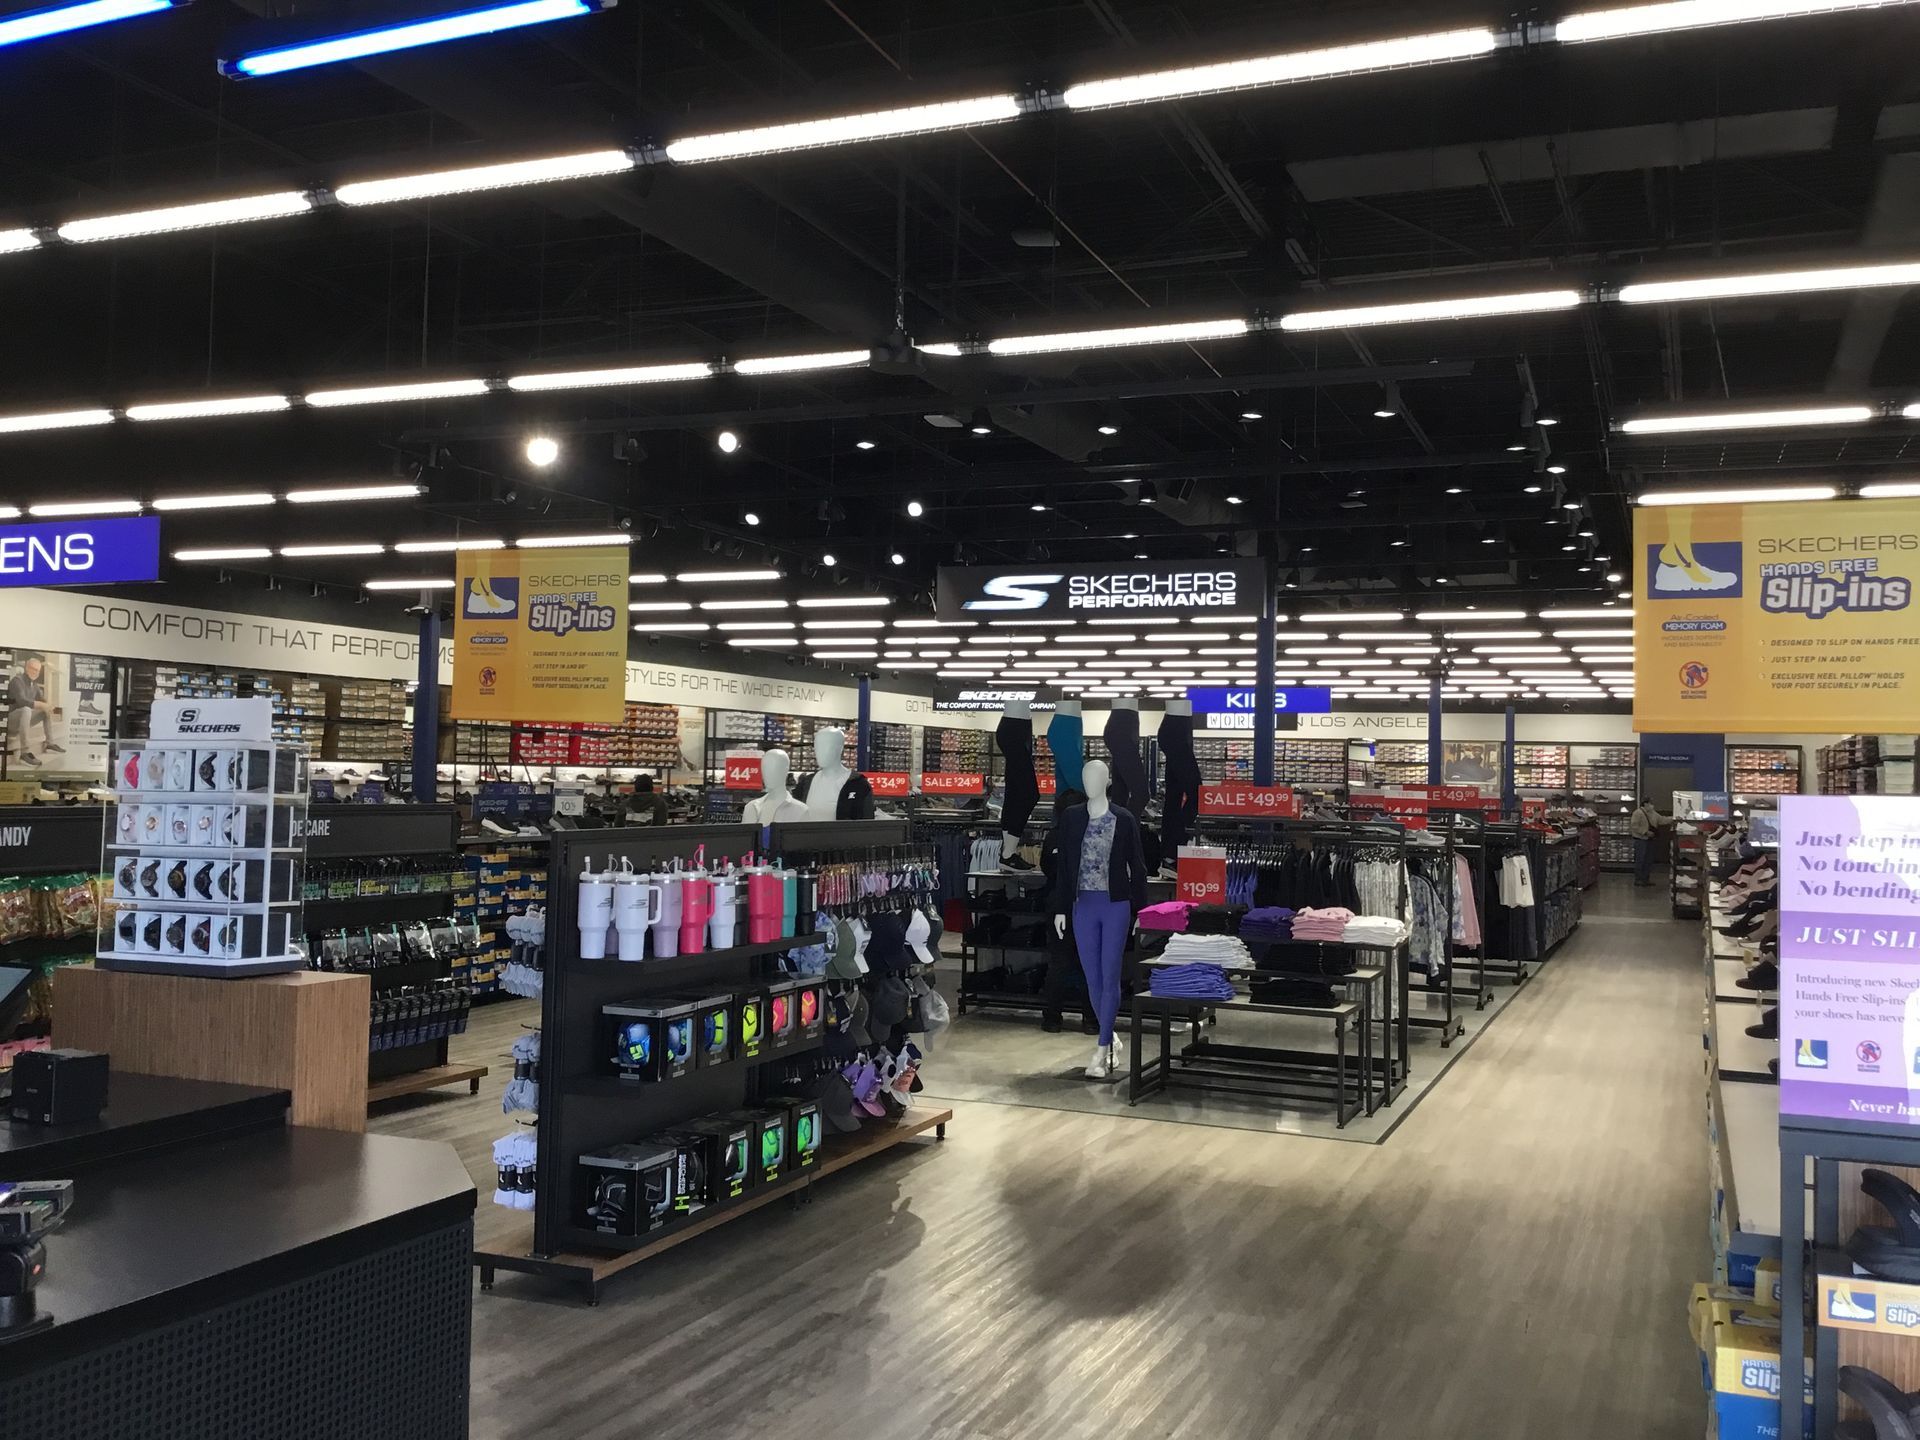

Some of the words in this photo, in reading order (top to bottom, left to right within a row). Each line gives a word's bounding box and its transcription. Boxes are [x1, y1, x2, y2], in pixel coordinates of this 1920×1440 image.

[1758, 535, 1920, 553] SKECHERS
[0, 533, 94, 573] ENS
[1760, 562, 1824, 577] HANDS
[1829, 558, 1878, 573] FREE
[529, 575, 621, 587] SKECHERS
[1069, 572, 1236, 594] SKECHERS
[529, 594, 566, 604] HANDS
[570, 592, 597, 603] FREE
[1069, 592, 1236, 608] PERFORMANCE
[1764, 576, 1908, 616] Slip-ins
[83, 604, 242, 642] COMFORT
[253, 625, 322, 650] THAT
[530, 604, 614, 634] Slip-ins
[1665, 622, 1699, 631] MEMORY
[1701, 622, 1724, 630] FOAM
[75, 681, 93, 689] WIDE
[681, 675, 709, 690] FOR
[713, 678, 737, 694] THE
[741, 681, 784, 698] WHOLE
[787, 687, 825, 702] FAMILY
[958, 691, 1037, 700] SKECHERS
[178, 724, 241, 733] SKECHERS
[1311, 717, 1346, 727] LOS
[1353, 717, 1427, 727] ANGELE
[925, 777, 952, 787] SALE
[954, 777, 980, 787] $24.99
[1204, 792, 1246, 805] SALE
[1248, 792, 1289, 806] $49.99
[1443, 790, 1475, 801] $49.99
[306, 820, 330, 836] CARE
[1795, 831, 1841, 847] Just
[1849, 835, 1894, 852] step
[1797, 856, 1827, 871] No
[1833, 858, 1920, 878] touchin
[1797, 880, 1827, 896] No
[1796, 927, 1866, 946] JUST
[1872, 929, 1920, 949] SLI
[1795, 973, 1861, 988] Introducing
[1795, 990, 1832, 1001] Hands
[1836, 992, 1859, 1003] Free
[1861, 994, 1906, 1006] Slip-ins
[1794, 1009, 1820, 1019] your
[1823, 1008, 1853, 1020] shoes
[1856, 1010, 1876, 1021] has
[1878, 1014, 1905, 1023] neve
[1848, 1099, 1894, 1115] Never
[1742, 1359, 1777, 1369] HANDS
[1745, 1367, 1780, 1393] Slip
[1757, 1425, 1779, 1437] THE
